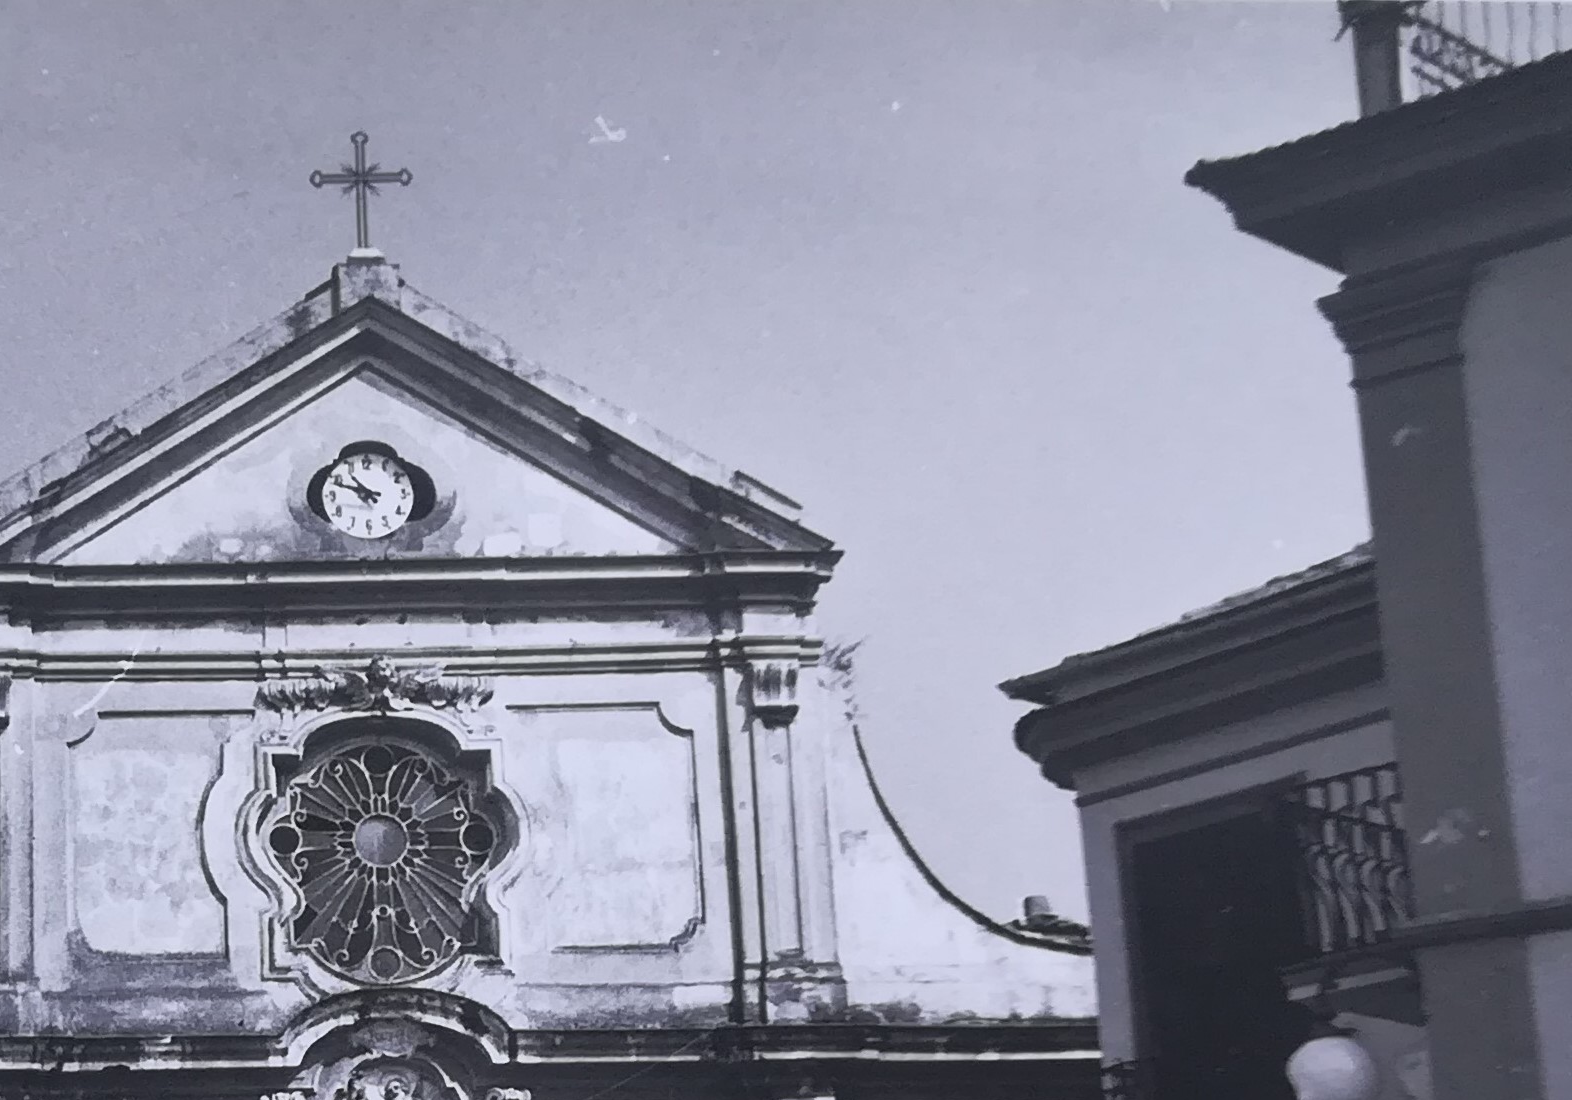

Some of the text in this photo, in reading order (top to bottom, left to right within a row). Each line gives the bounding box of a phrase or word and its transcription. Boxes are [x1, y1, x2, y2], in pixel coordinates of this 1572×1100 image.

[329, 490, 336, 502] 9
[335, 505, 342, 518] 8
[395, 505, 402, 515] 4
[366, 519, 373, 531] 6
[381, 515, 389, 528] 5
